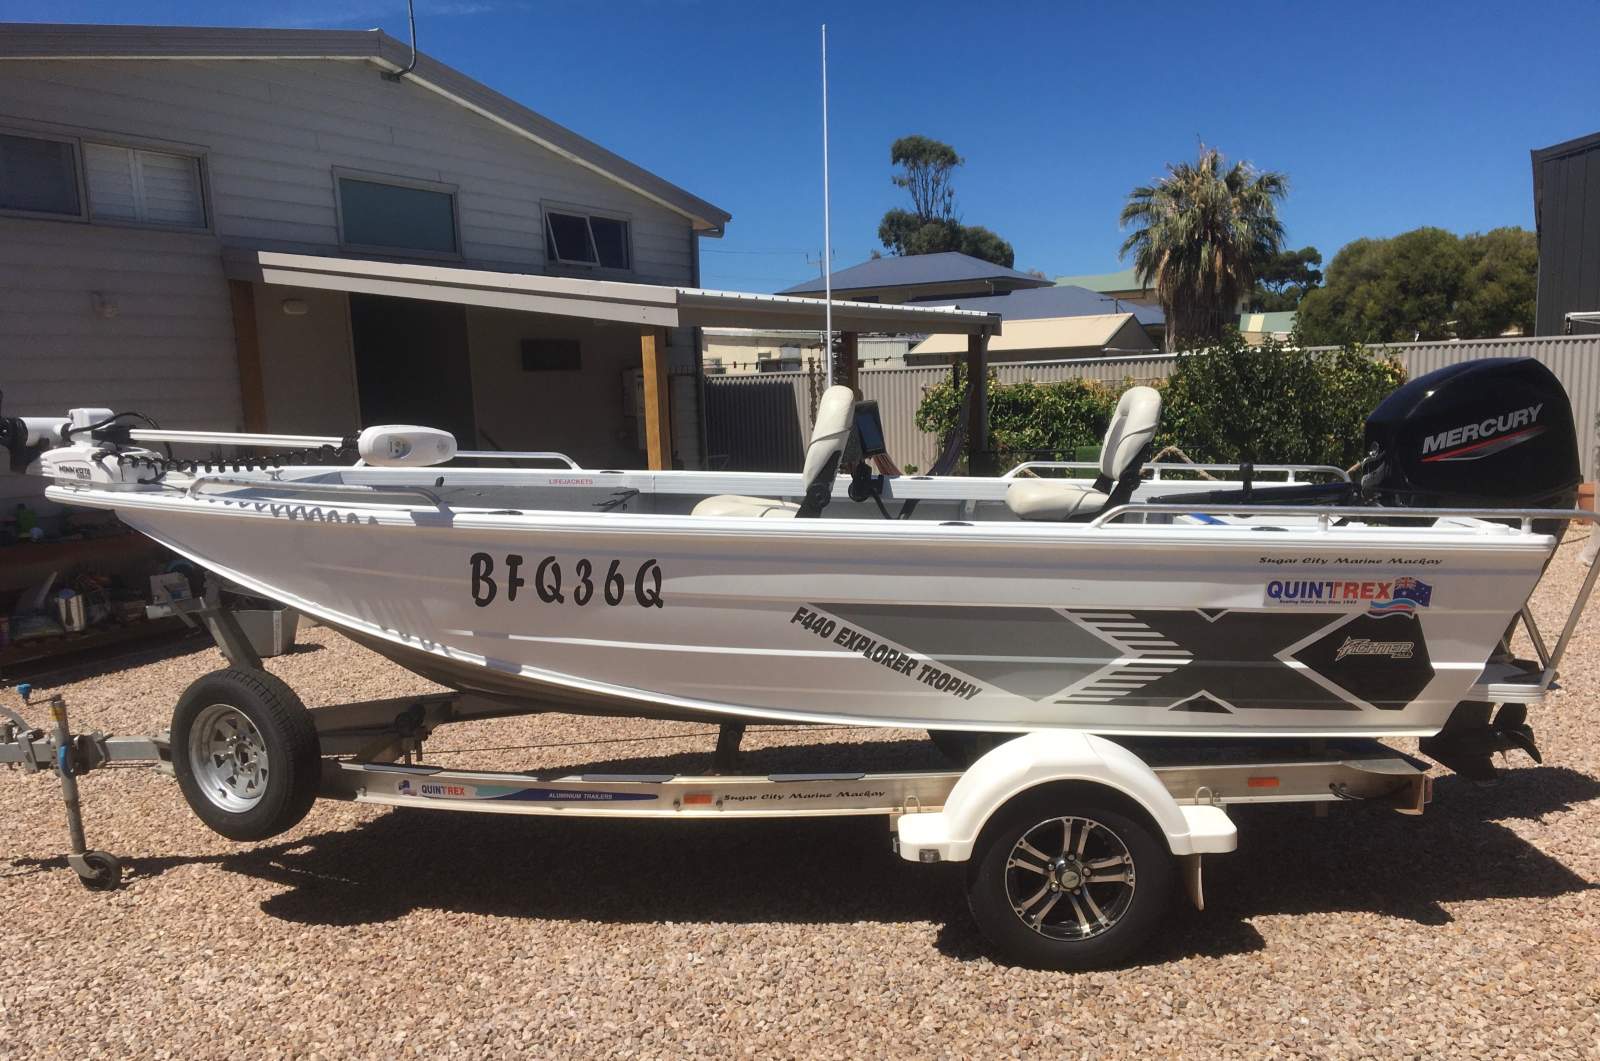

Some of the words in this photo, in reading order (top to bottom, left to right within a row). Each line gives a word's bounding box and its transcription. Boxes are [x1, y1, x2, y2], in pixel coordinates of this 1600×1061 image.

[1422, 403, 1543, 454] MERCURY
[1258, 556, 1298, 565] Sugar
[1302, 556, 1329, 565] City
[1333, 557, 1383, 565] Marine
[1387, 557, 1443, 565] Mackay
[1267, 580, 1394, 600] QUINTREX
[790, 606, 836, 638] F440
[833, 626, 919, 676] EXPLORER
[916, 664, 983, 700] TROPHY
[421, 784, 465, 796] QUINTREX
[550, 792, 582, 800] ALUMINIUM
[761, 793, 785, 801] City
[836, 790, 886, 799] Mackay
